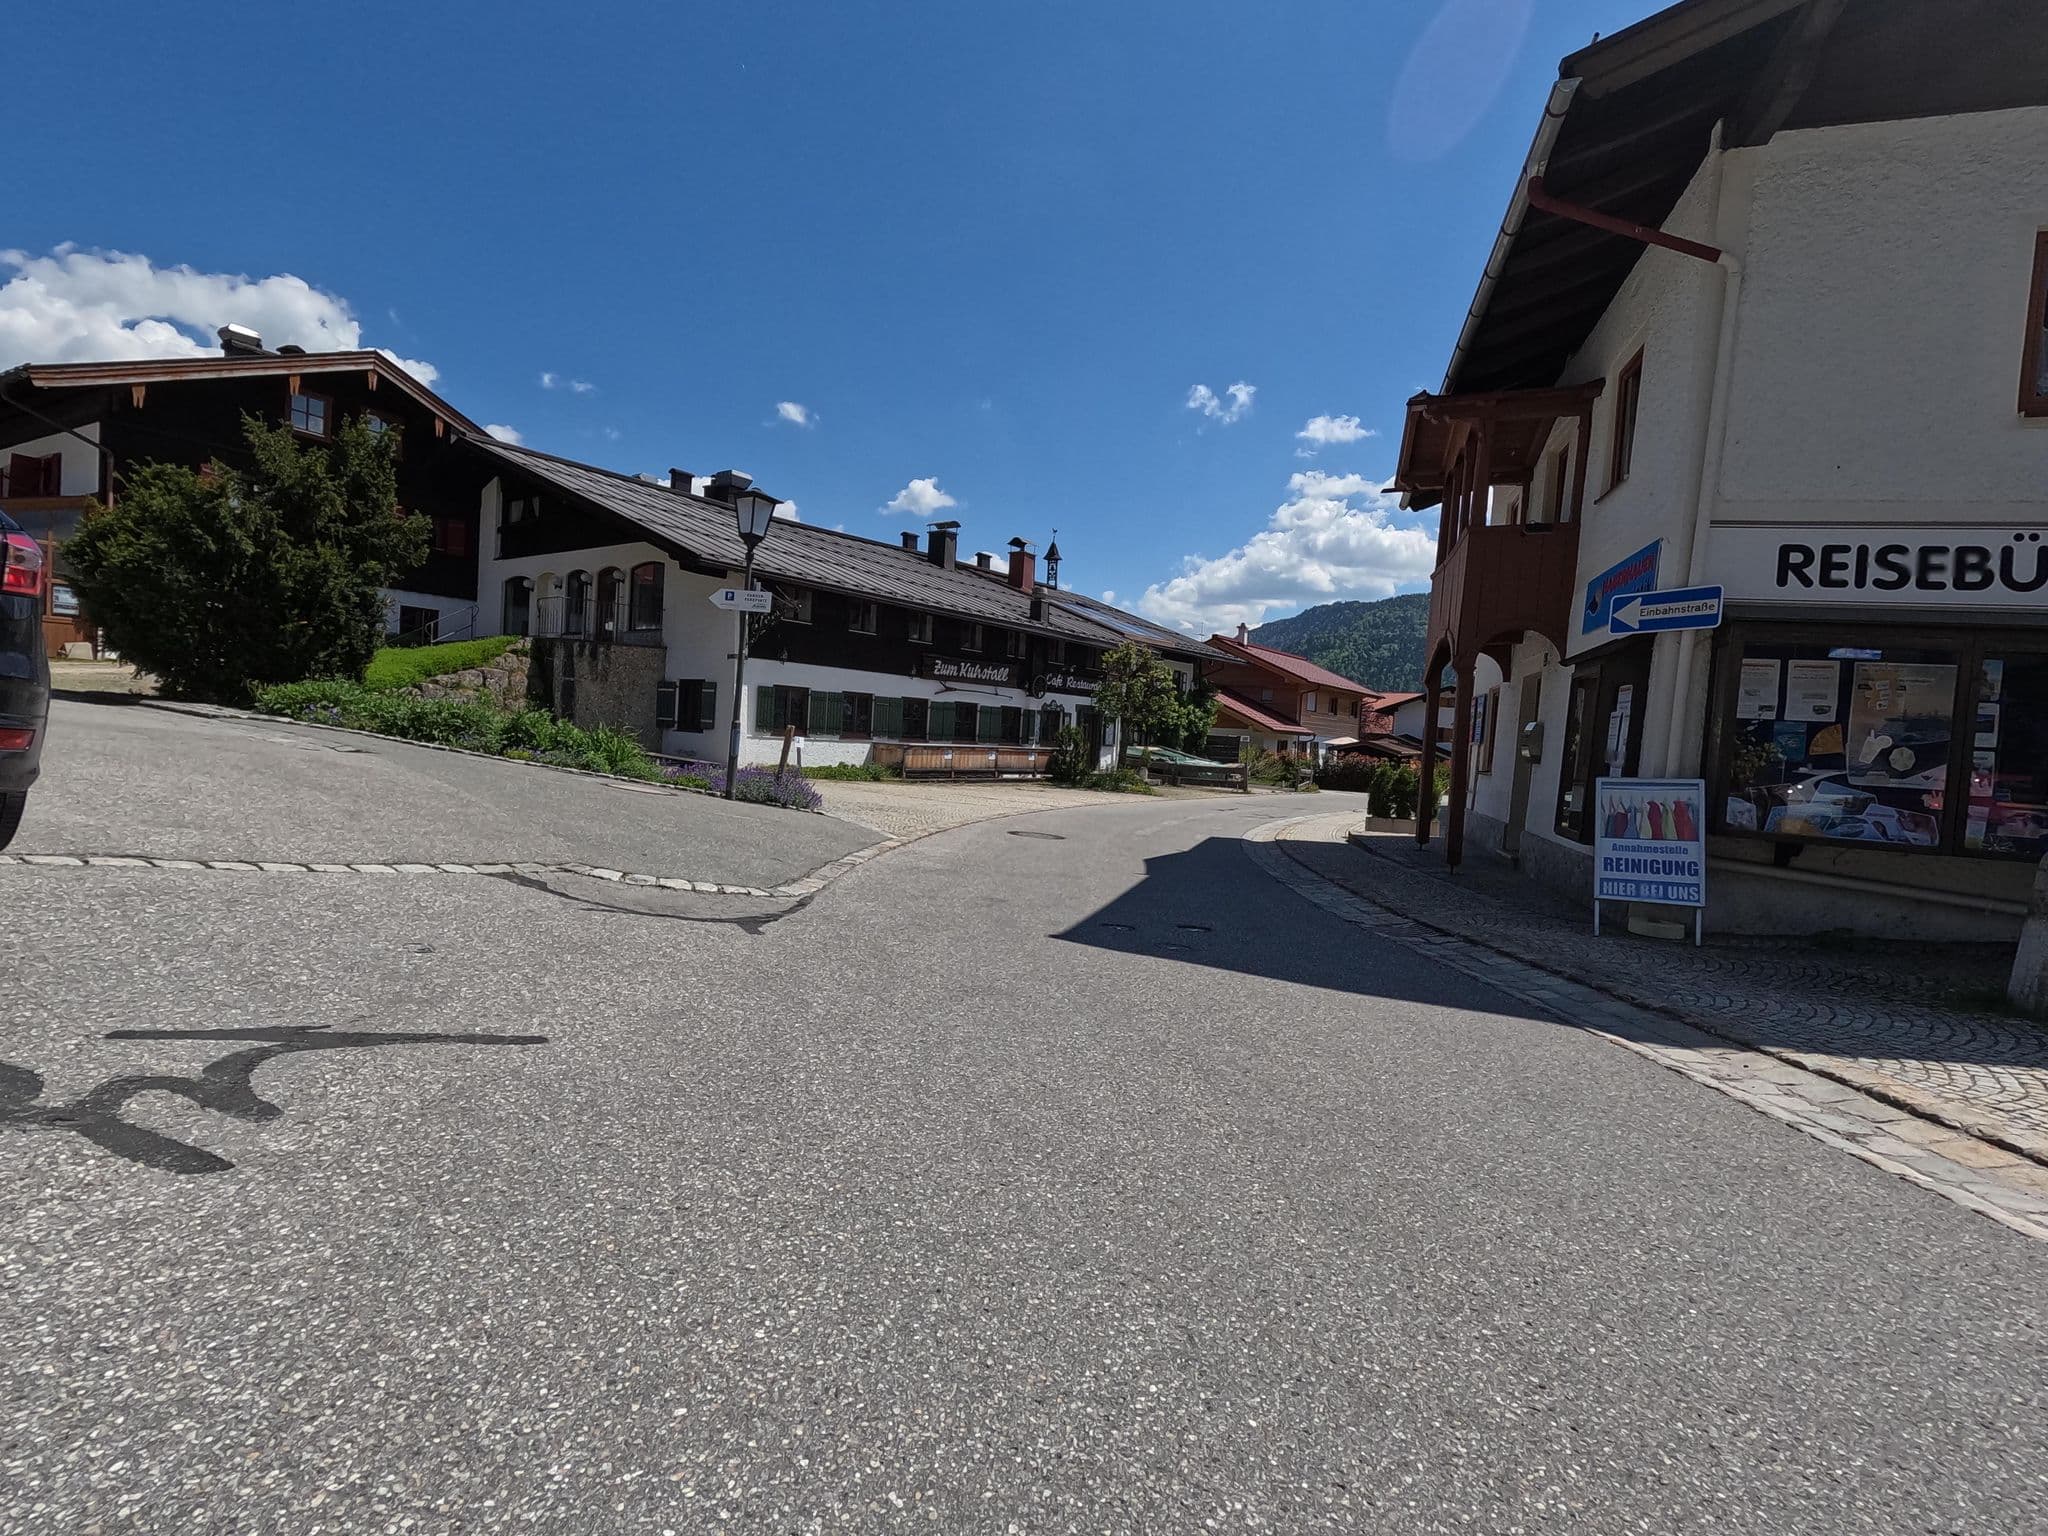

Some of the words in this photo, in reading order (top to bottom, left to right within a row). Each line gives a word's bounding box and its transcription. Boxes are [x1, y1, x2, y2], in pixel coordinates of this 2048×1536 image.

[1776, 532, 2048, 593] REISEBÜ
[1640, 602, 1716, 617] Einbahnstraße
[934, 659, 958, 677] Zum
[959, 662, 1009, 682] Kuhstall
[1046, 672, 1063, 688] Café
[1612, 843, 1688, 855] Annahmestelle
[1603, 857, 1699, 877] REINIGUNG
[1603, 881, 1636, 896] HIER
[1640, 883, 1664, 898] BEI
[1667, 886, 1699, 901] UNS
